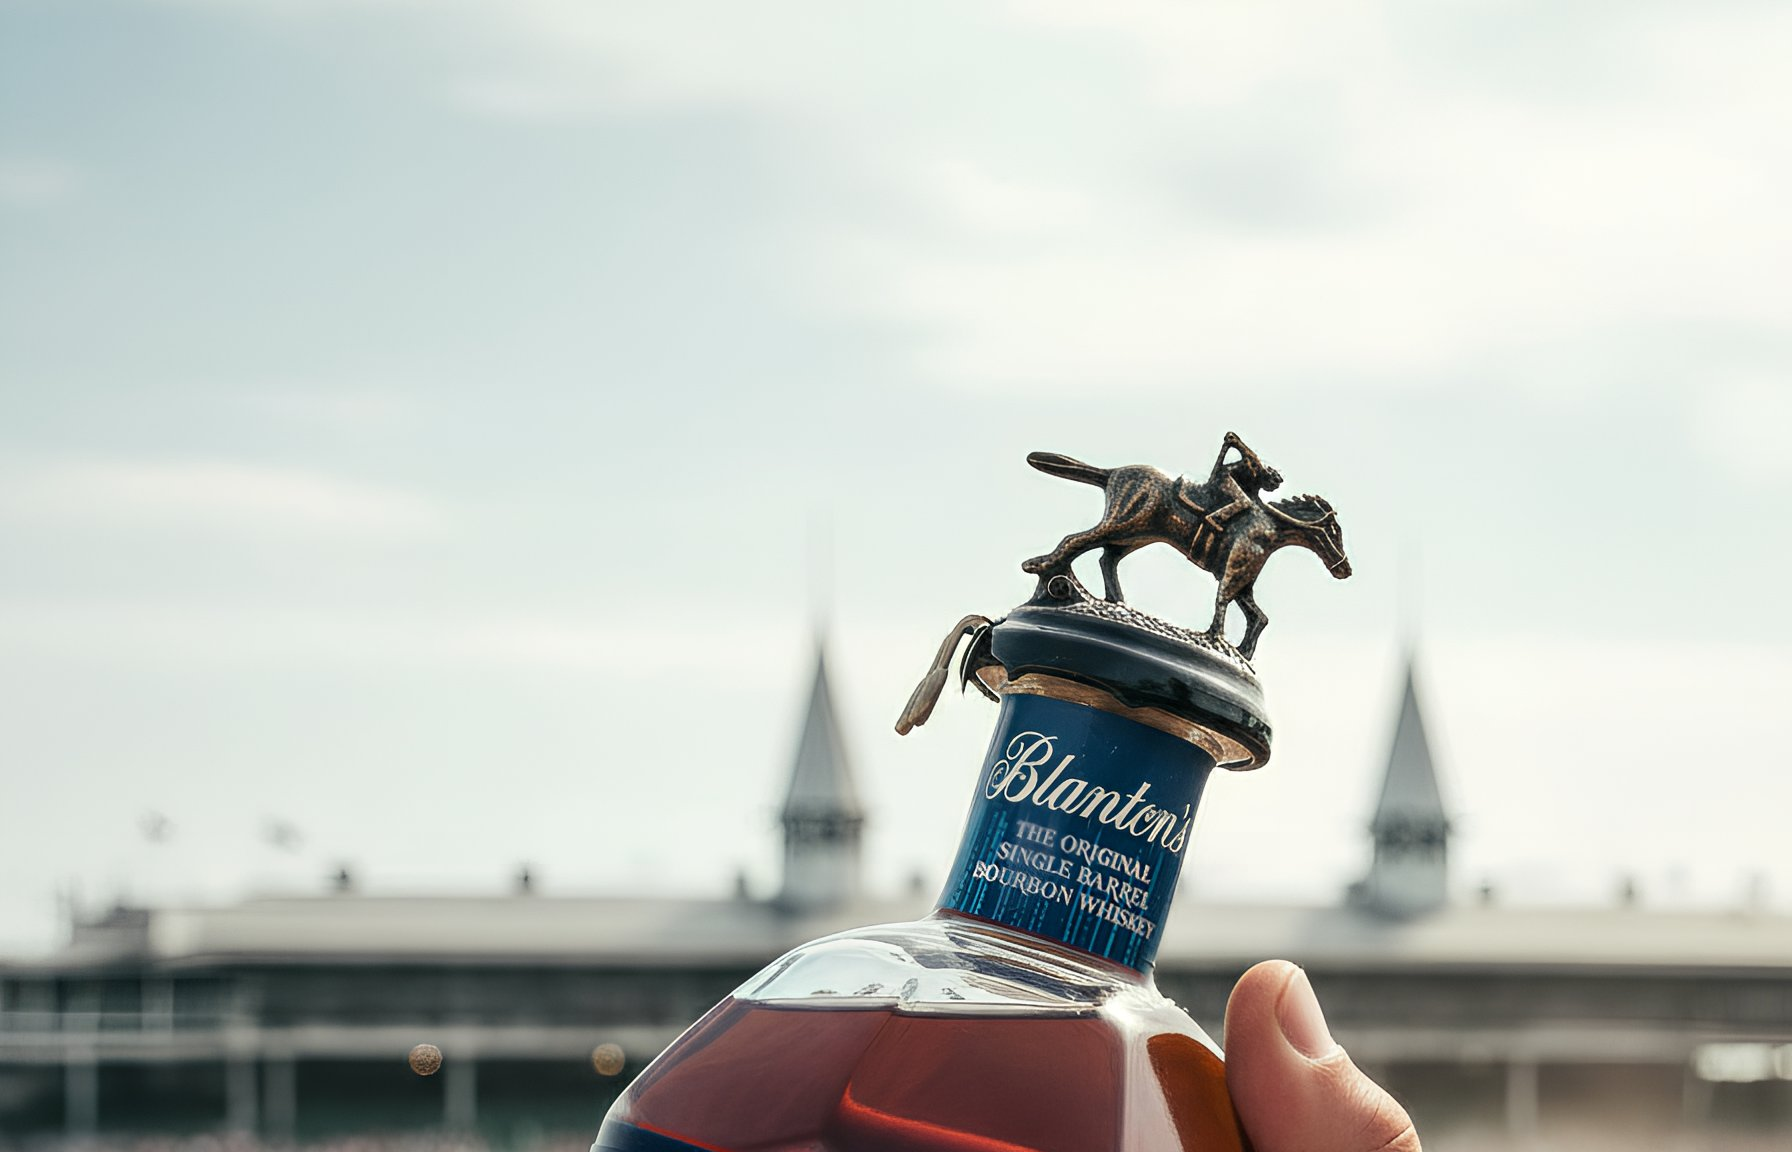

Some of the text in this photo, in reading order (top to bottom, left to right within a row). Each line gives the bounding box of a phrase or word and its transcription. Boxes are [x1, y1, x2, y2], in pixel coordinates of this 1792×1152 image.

[985, 731, 1191, 853] Blanton's
[996, 842, 1149, 911] SINGLE BARREL
[1015, 820, 1152, 885] THE ORIGINAL
[973, 861, 1157, 940] BOURBON WHISKEY
